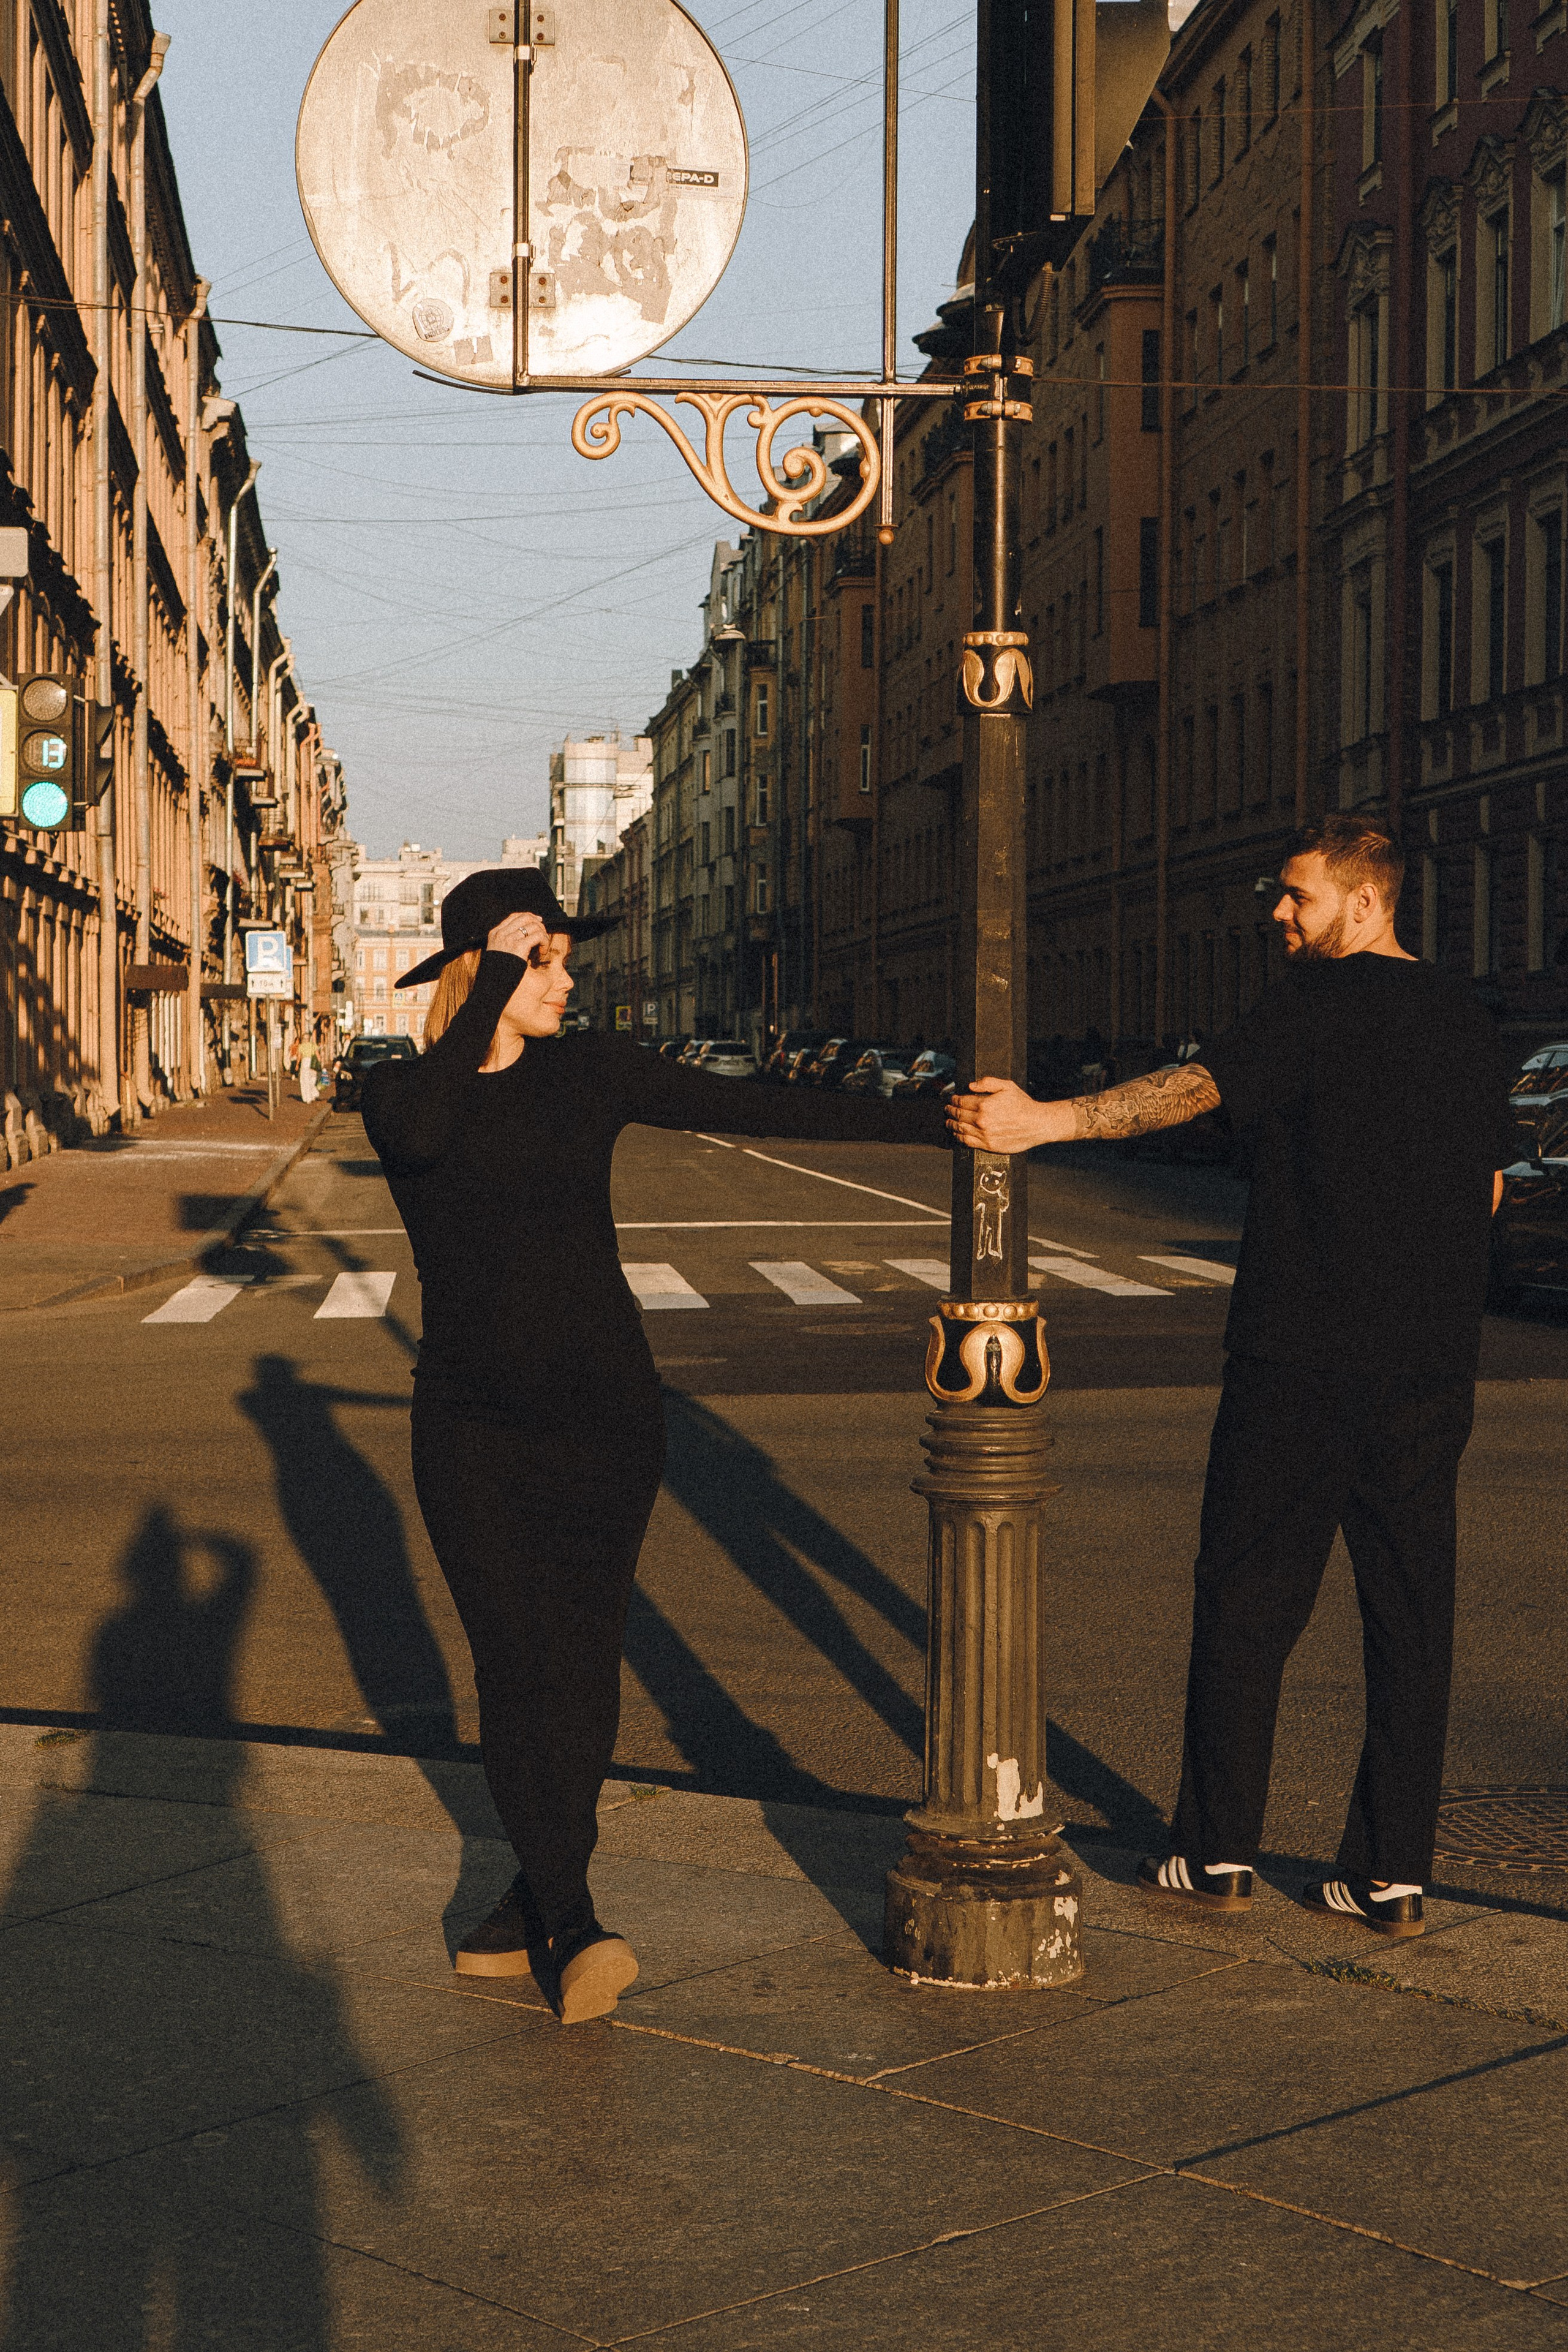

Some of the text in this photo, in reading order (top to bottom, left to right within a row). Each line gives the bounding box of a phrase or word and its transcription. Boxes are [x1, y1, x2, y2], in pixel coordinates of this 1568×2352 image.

[42, 738, 64, 768] 13
[258, 936, 279, 966] P
[647, 1003, 655, 1014] P
